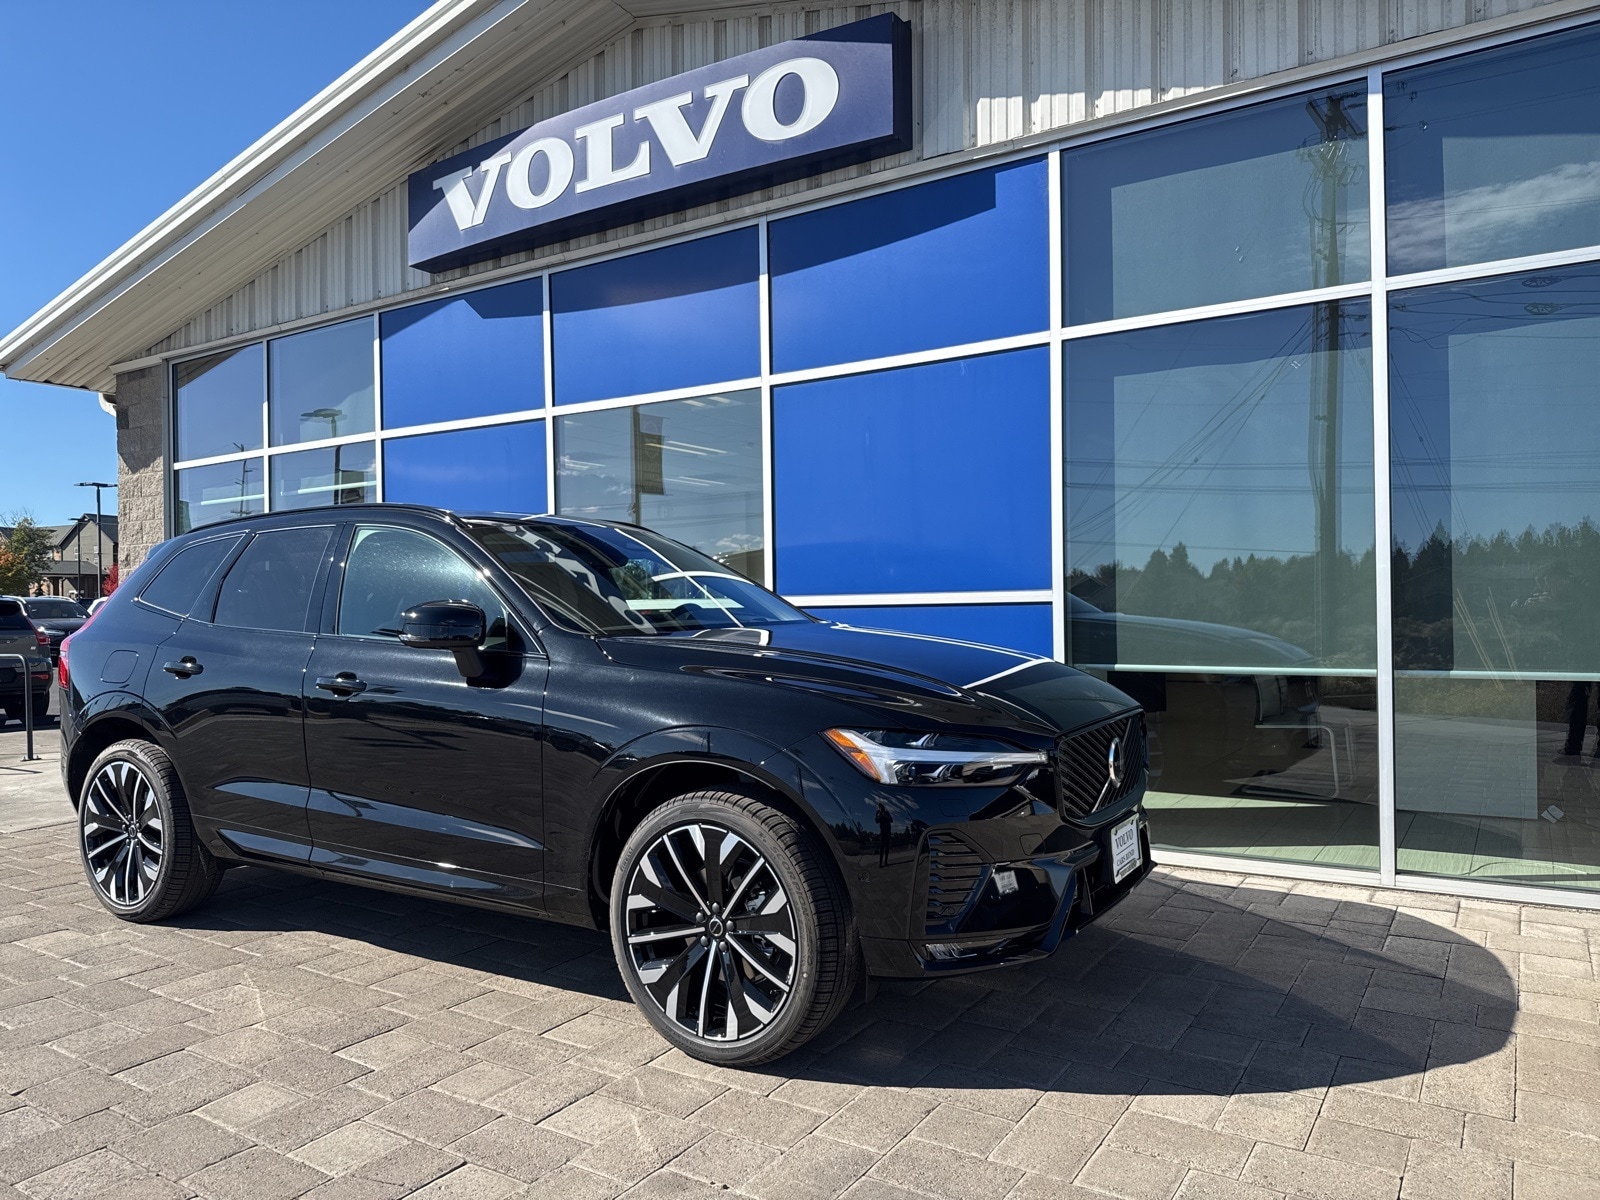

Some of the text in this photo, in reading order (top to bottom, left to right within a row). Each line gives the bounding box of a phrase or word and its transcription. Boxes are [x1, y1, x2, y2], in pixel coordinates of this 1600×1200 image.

[432, 57, 840, 231] VOLVO
[1115, 828, 1134, 849] VOLVO
[1117, 856, 1126, 866] CARS
[769, 844, 810, 918] SCORPION
